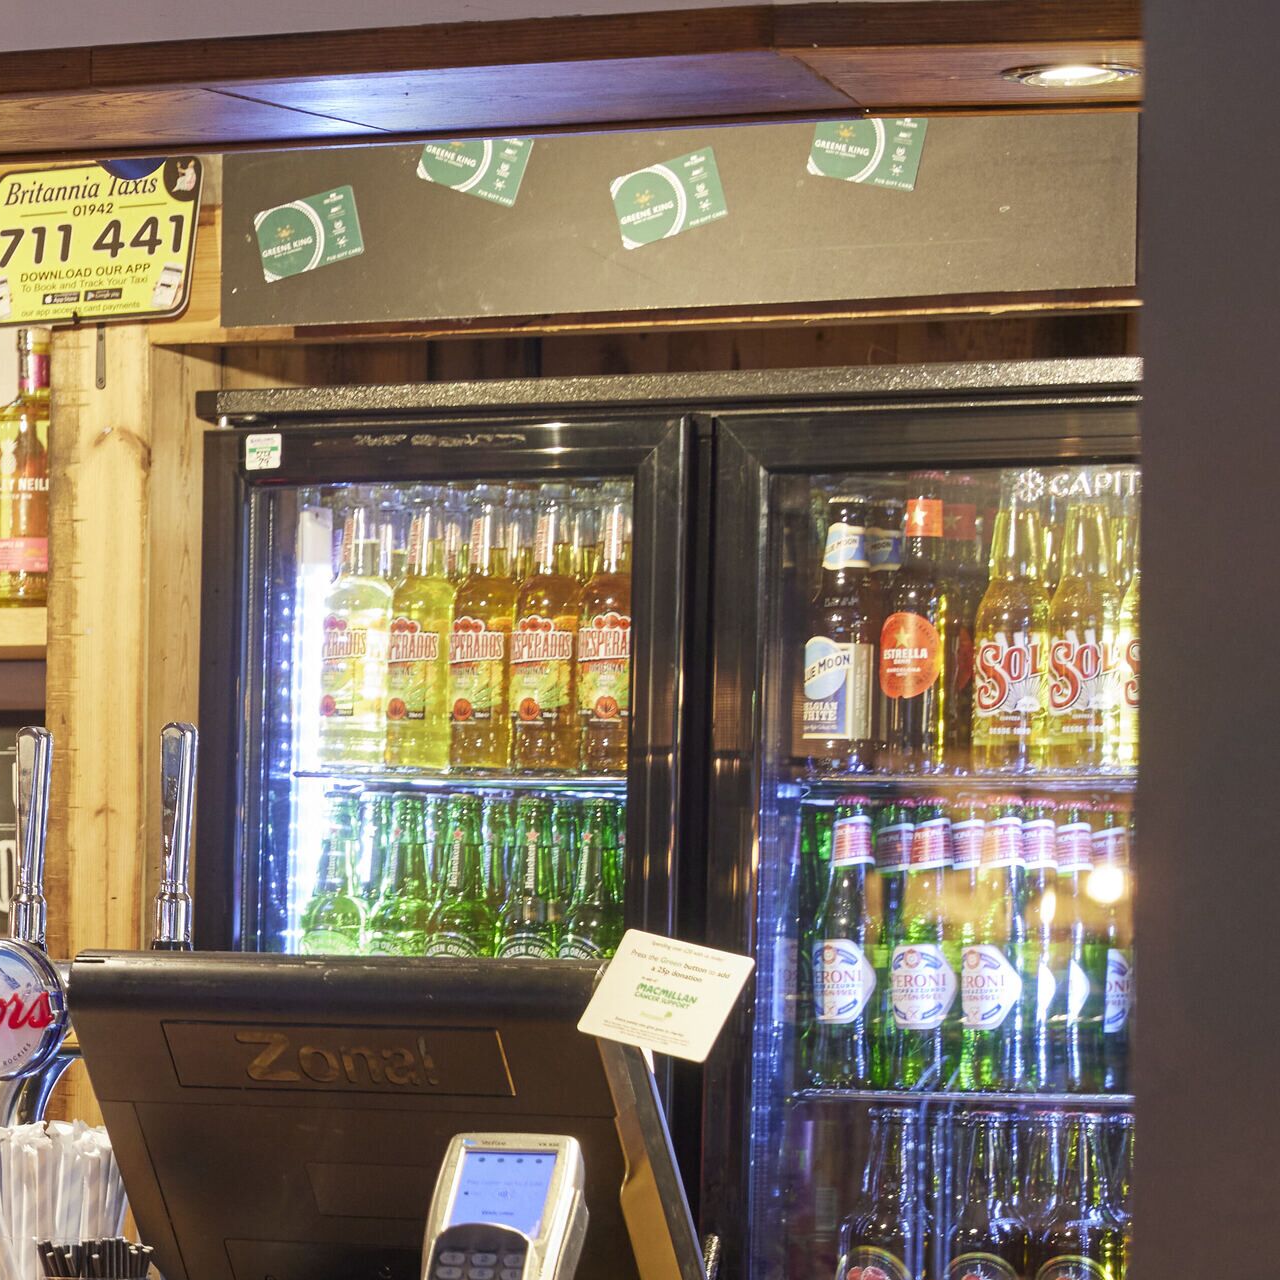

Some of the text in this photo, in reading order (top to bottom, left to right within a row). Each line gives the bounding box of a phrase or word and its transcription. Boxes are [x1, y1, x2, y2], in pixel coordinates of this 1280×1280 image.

[426, 144, 456, 160] GREENE
[456, 154, 477, 168] KING
[815, 139, 848, 152] GREENE
[848, 145, 870, 156] KING
[4, 176, 158, 206] Britannia Taxis
[72, 203, 114, 217] 01942
[620, 200, 674, 225] GREENE KING
[0, 214, 185, 268] 711 441
[262, 243, 292, 258] GREENE
[293, 236, 313, 248] KING
[20, 263, 151, 283] DOWNLOAD OUR APP
[21, 275, 148, 293] To Book and Track Your Taxi
[35, 308, 50, 318] app
[52, 305, 82, 316] accepts
[84, 303, 101, 313] card
[103, 301, 140, 313] payments
[1050, 471, 1141, 498] CAPIT
[579, 629, 630, 658] DESPERA
[884, 648, 928, 660] ESTRELLA
[818, 654, 851, 674] MOON
[449, 838, 461, 888] Heineken
[525, 844, 537, 889] Heineken
[578, 845, 590, 891] Heineken
[630, 949, 646, 958] Press
[648, 954, 659, 962] the
[683, 963, 707, 974] button
[717, 971, 731, 979] add
[657, 966, 670, 976] 25p
[671, 969, 703, 983] donation
[815, 970, 862, 983] ERONI
[634, 991, 690, 1009] CANCER SUPPORT
[636, 983, 698, 1005] MACMILLAN
[3, 1042, 32, 1066] ROCKIES
[236, 1031, 442, 1087] Zonal
